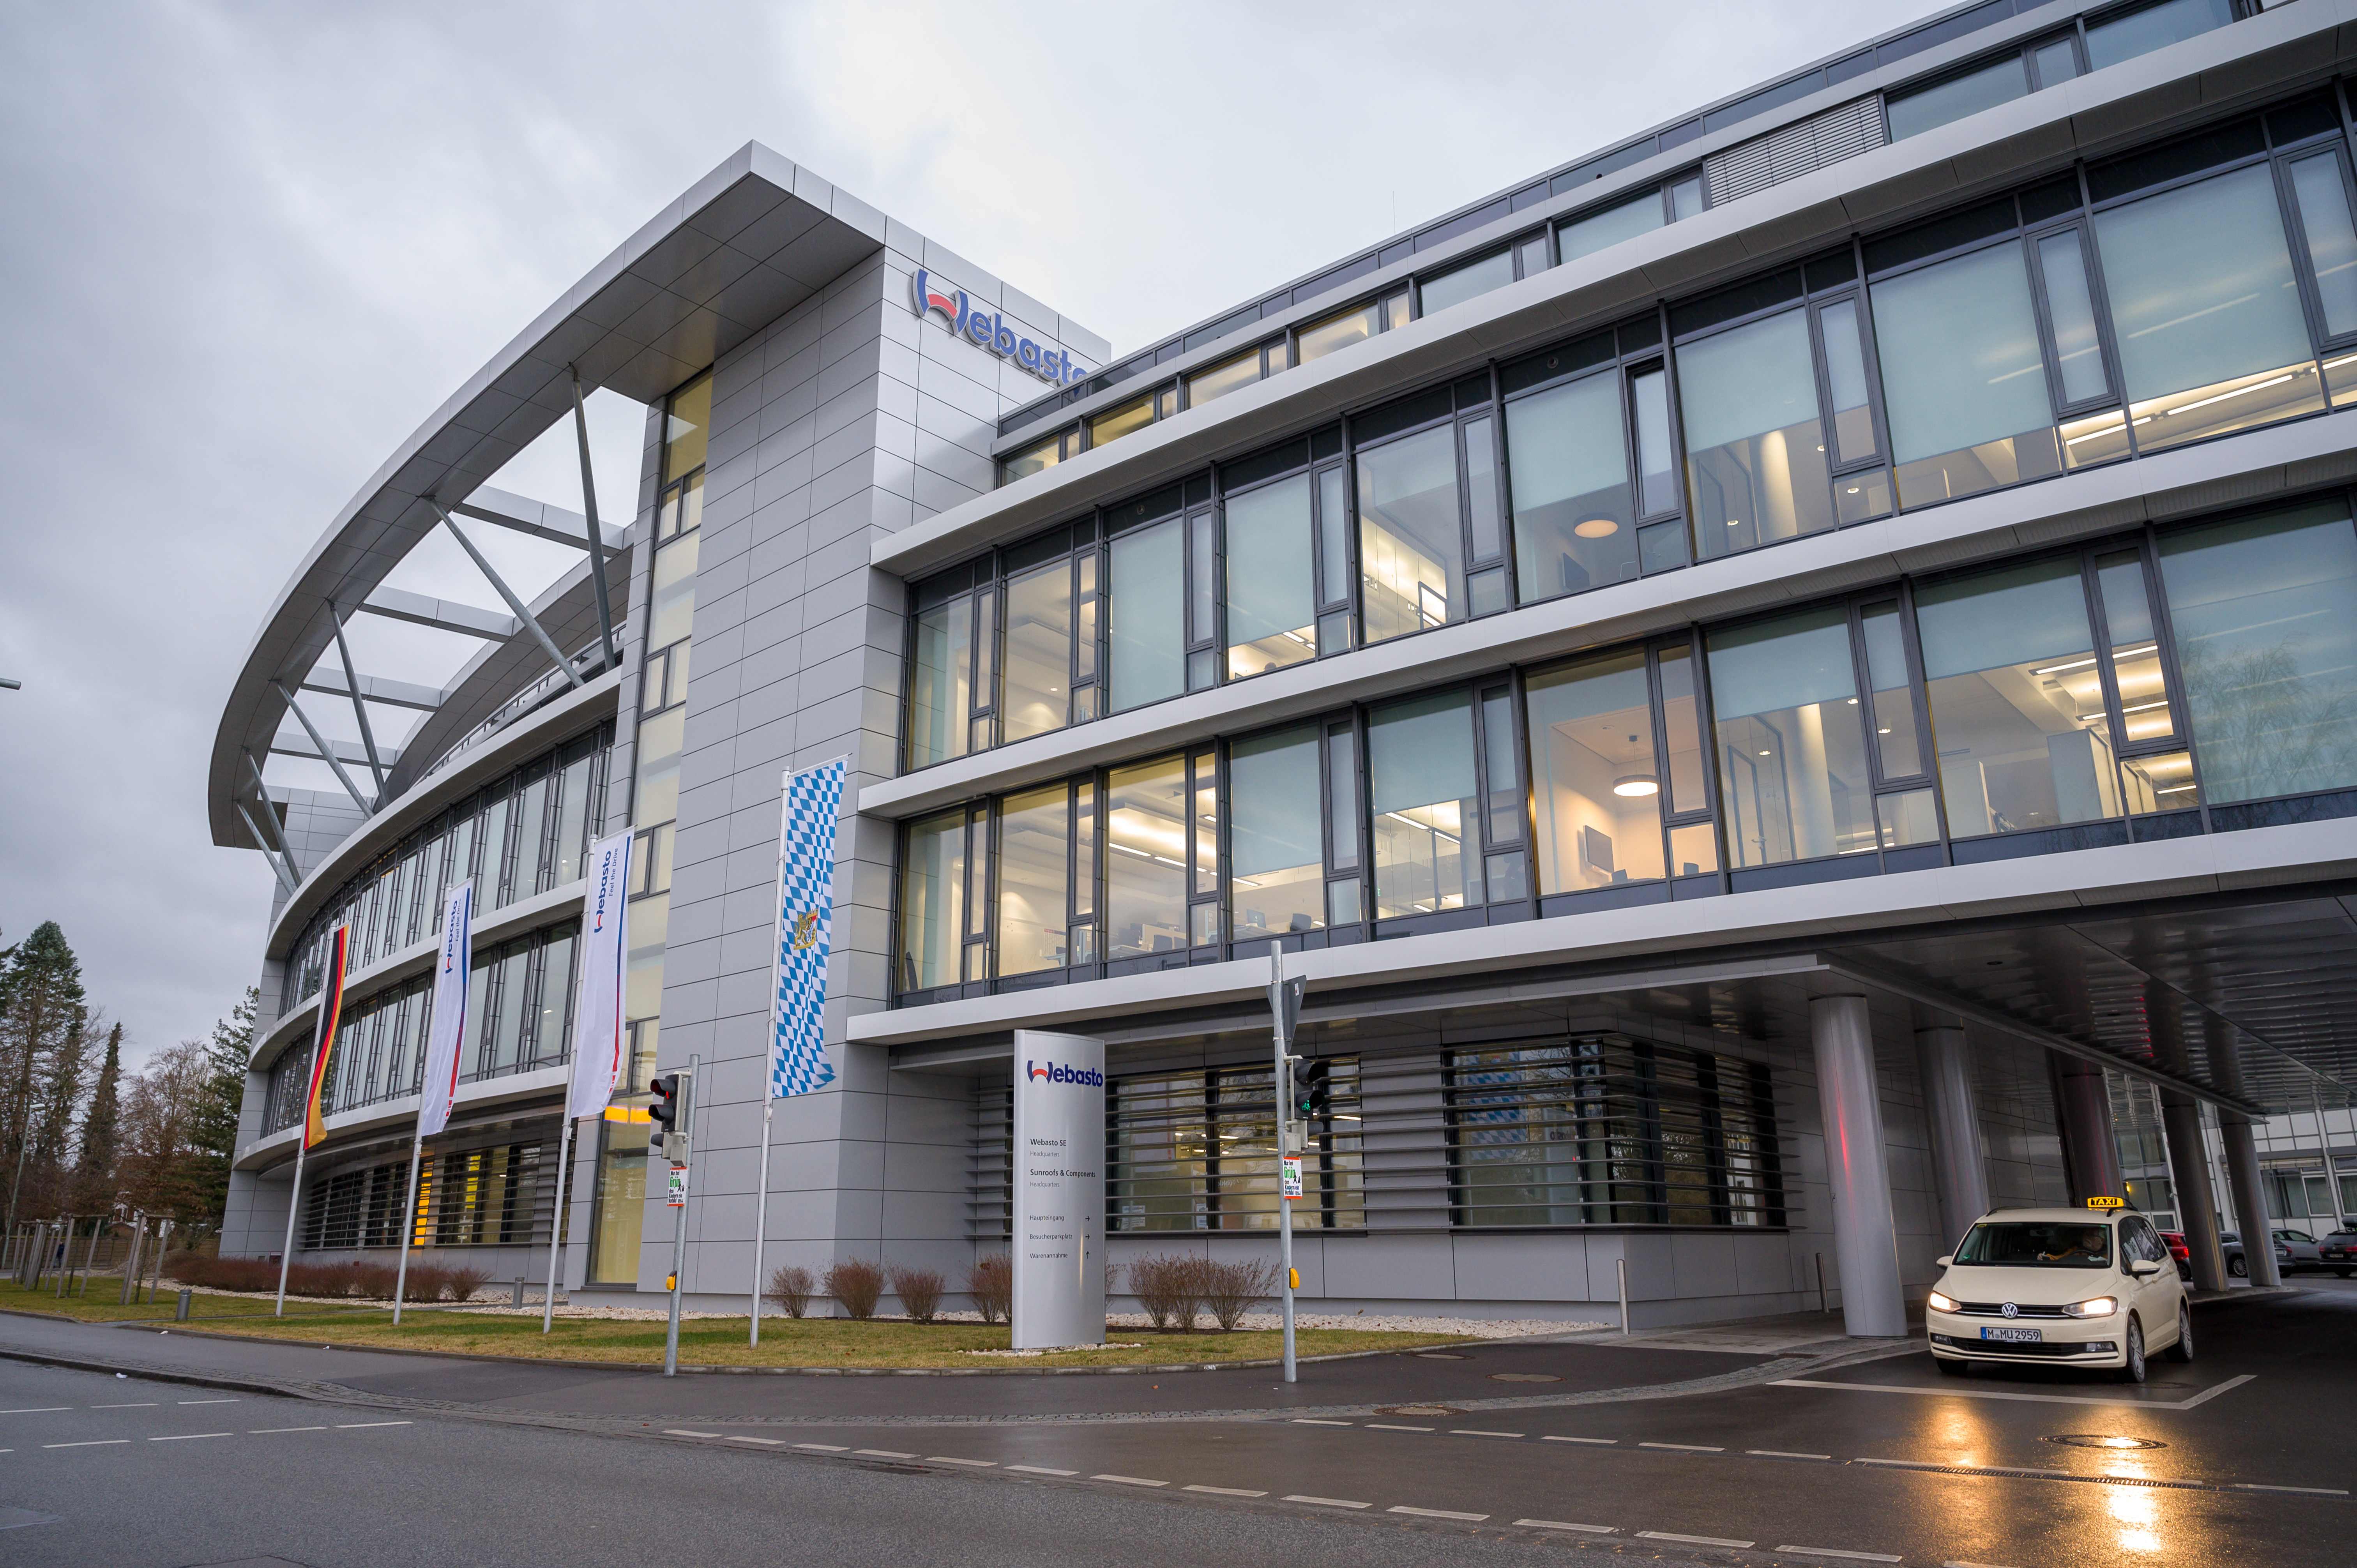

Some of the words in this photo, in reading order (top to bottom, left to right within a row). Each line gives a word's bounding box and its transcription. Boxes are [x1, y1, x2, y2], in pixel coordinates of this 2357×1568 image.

[594, 851, 611, 933] Webasto
[445, 900, 458, 974] Webasto
[1027, 1060, 1103, 1087] Webasto
[1066, 1170, 1095, 1178] Components
[1988, 1329, 1994, 1338] M
[2000, 1330, 2013, 1339] MU
[2015, 1330, 2039, 1340] 2959
